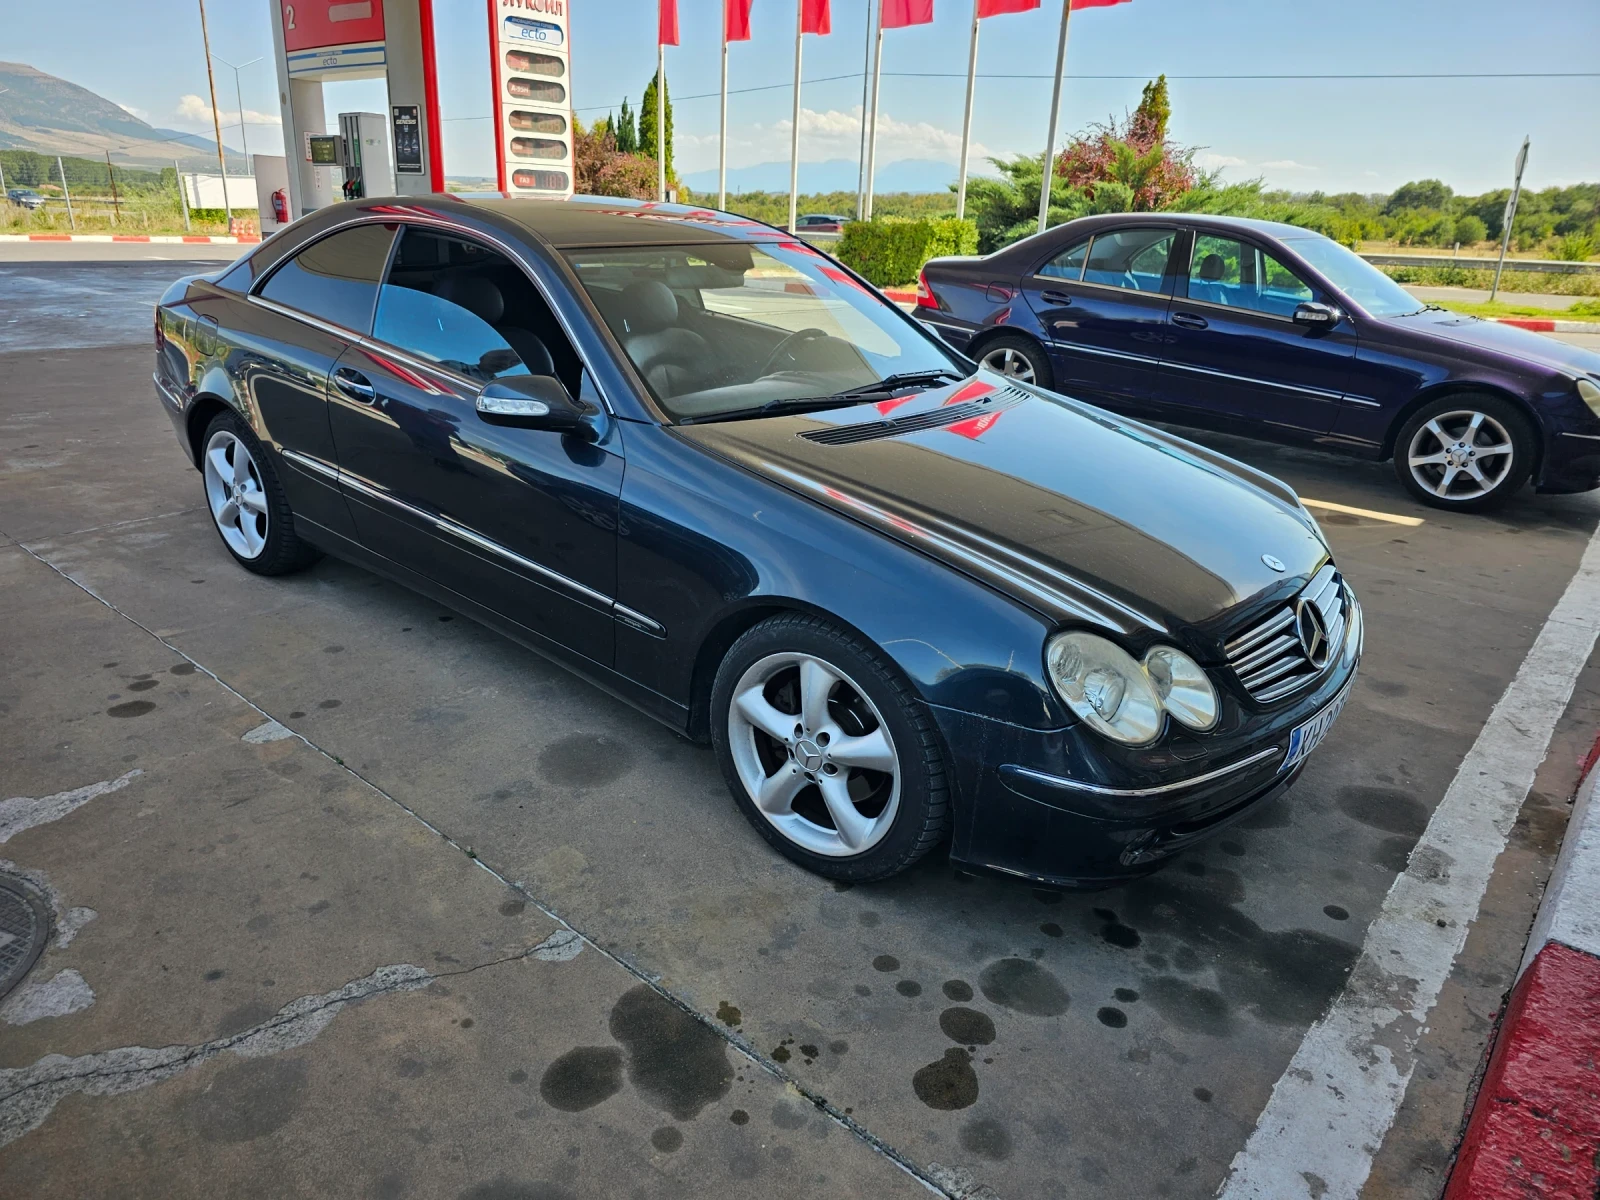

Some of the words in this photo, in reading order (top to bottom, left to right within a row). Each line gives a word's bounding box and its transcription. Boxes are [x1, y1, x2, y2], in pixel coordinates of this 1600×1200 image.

[286, 5, 296, 30] 2
[521, 28, 547, 40] ecto
[322, 57, 338, 66] ecto
